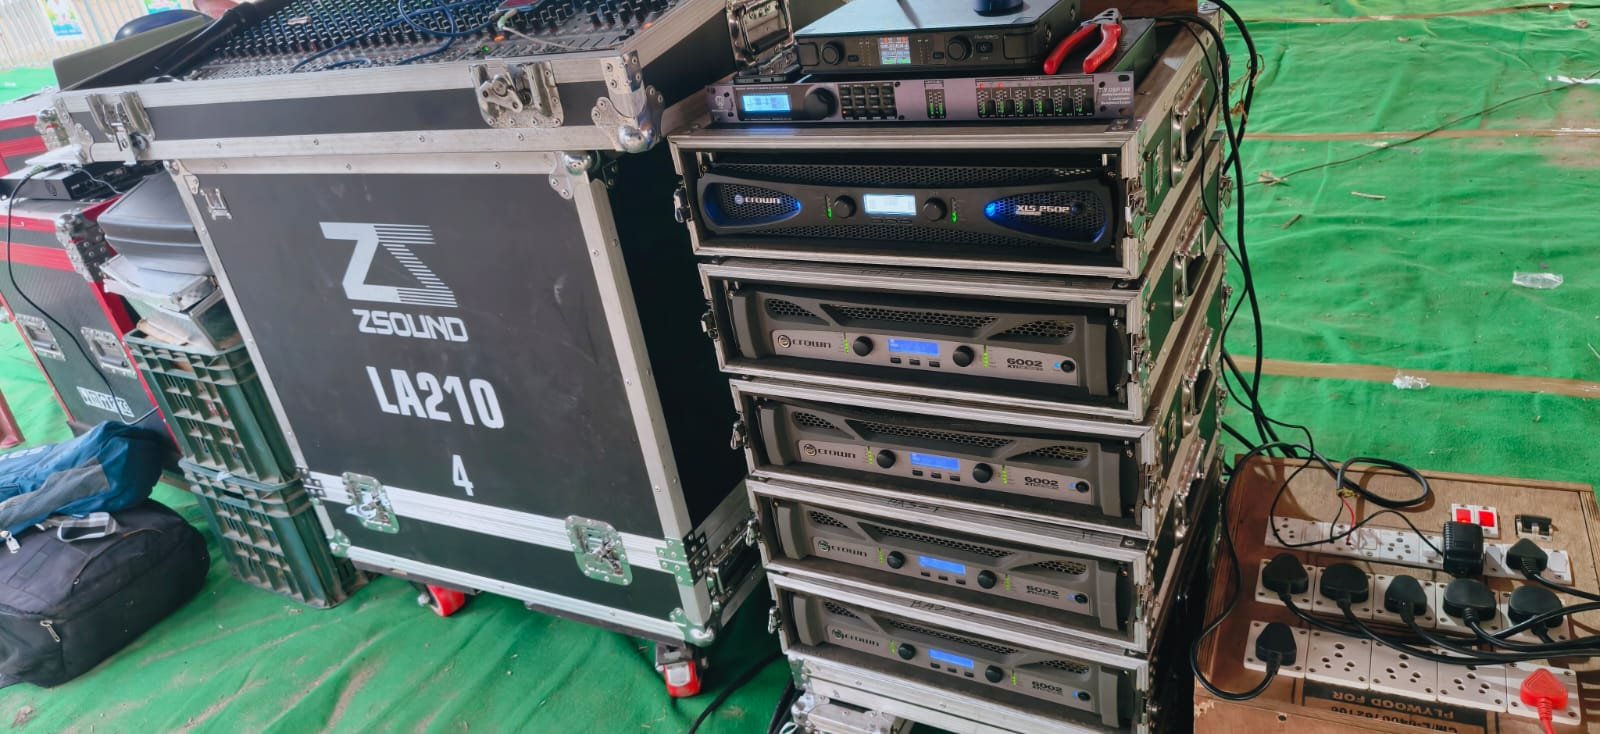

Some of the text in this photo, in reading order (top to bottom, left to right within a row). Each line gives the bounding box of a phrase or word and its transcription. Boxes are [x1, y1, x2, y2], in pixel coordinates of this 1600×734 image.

[1016, 204, 1036, 212] XLS
[352, 308, 469, 342] ZSOUND
[1007, 358, 1043, 367] 6002
[366, 365, 504, 429] LA210
[452, 454, 475, 497] 4
[1024, 476, 1059, 487] 6002
[1332, 691, 1455, 719] PLYWOOD FOR
